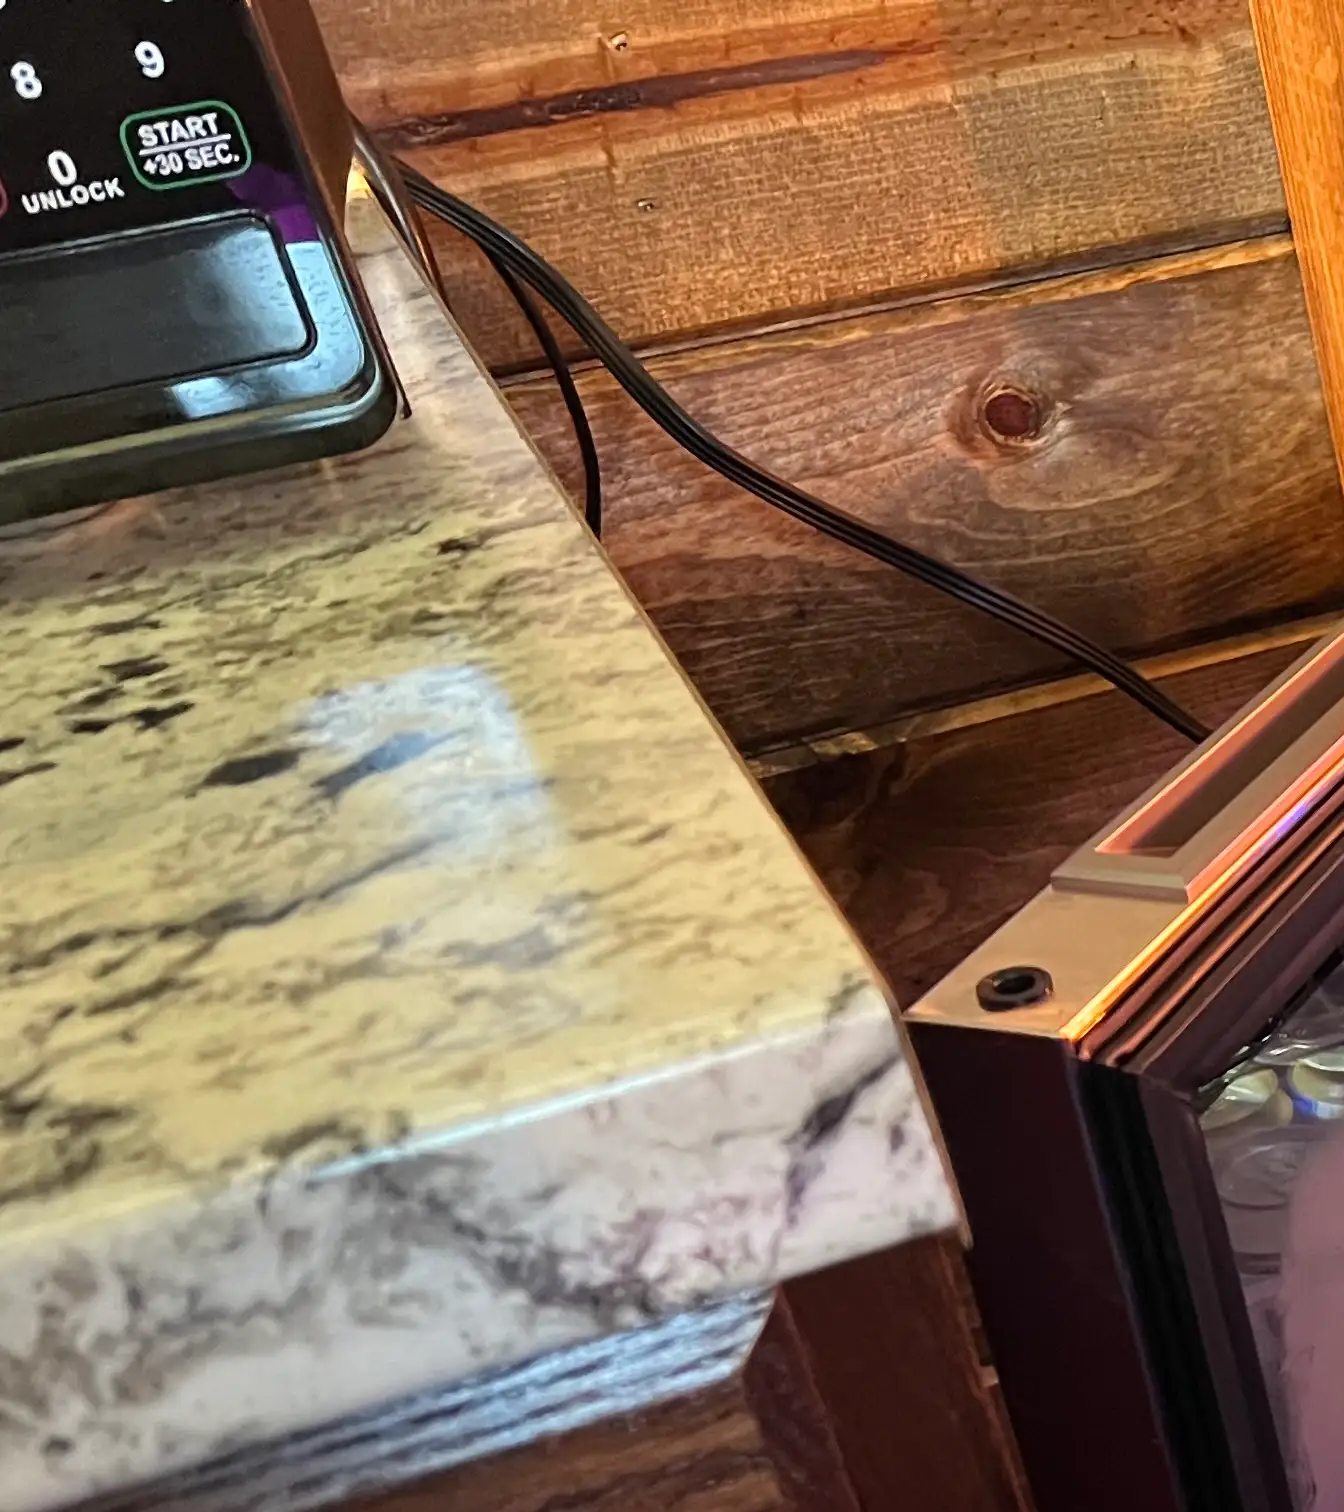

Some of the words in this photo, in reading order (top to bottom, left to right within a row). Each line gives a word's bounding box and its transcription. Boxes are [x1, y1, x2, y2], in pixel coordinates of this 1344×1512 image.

[134, 40, 164, 78] 9
[10, 61, 42, 99] 8
[138, 112, 218, 148] START
[47, 150, 77, 186] 0
[144, 153, 182, 177] +30
[184, 144, 240, 170] SEC.
[21, 177, 126, 214] UNLOCK
